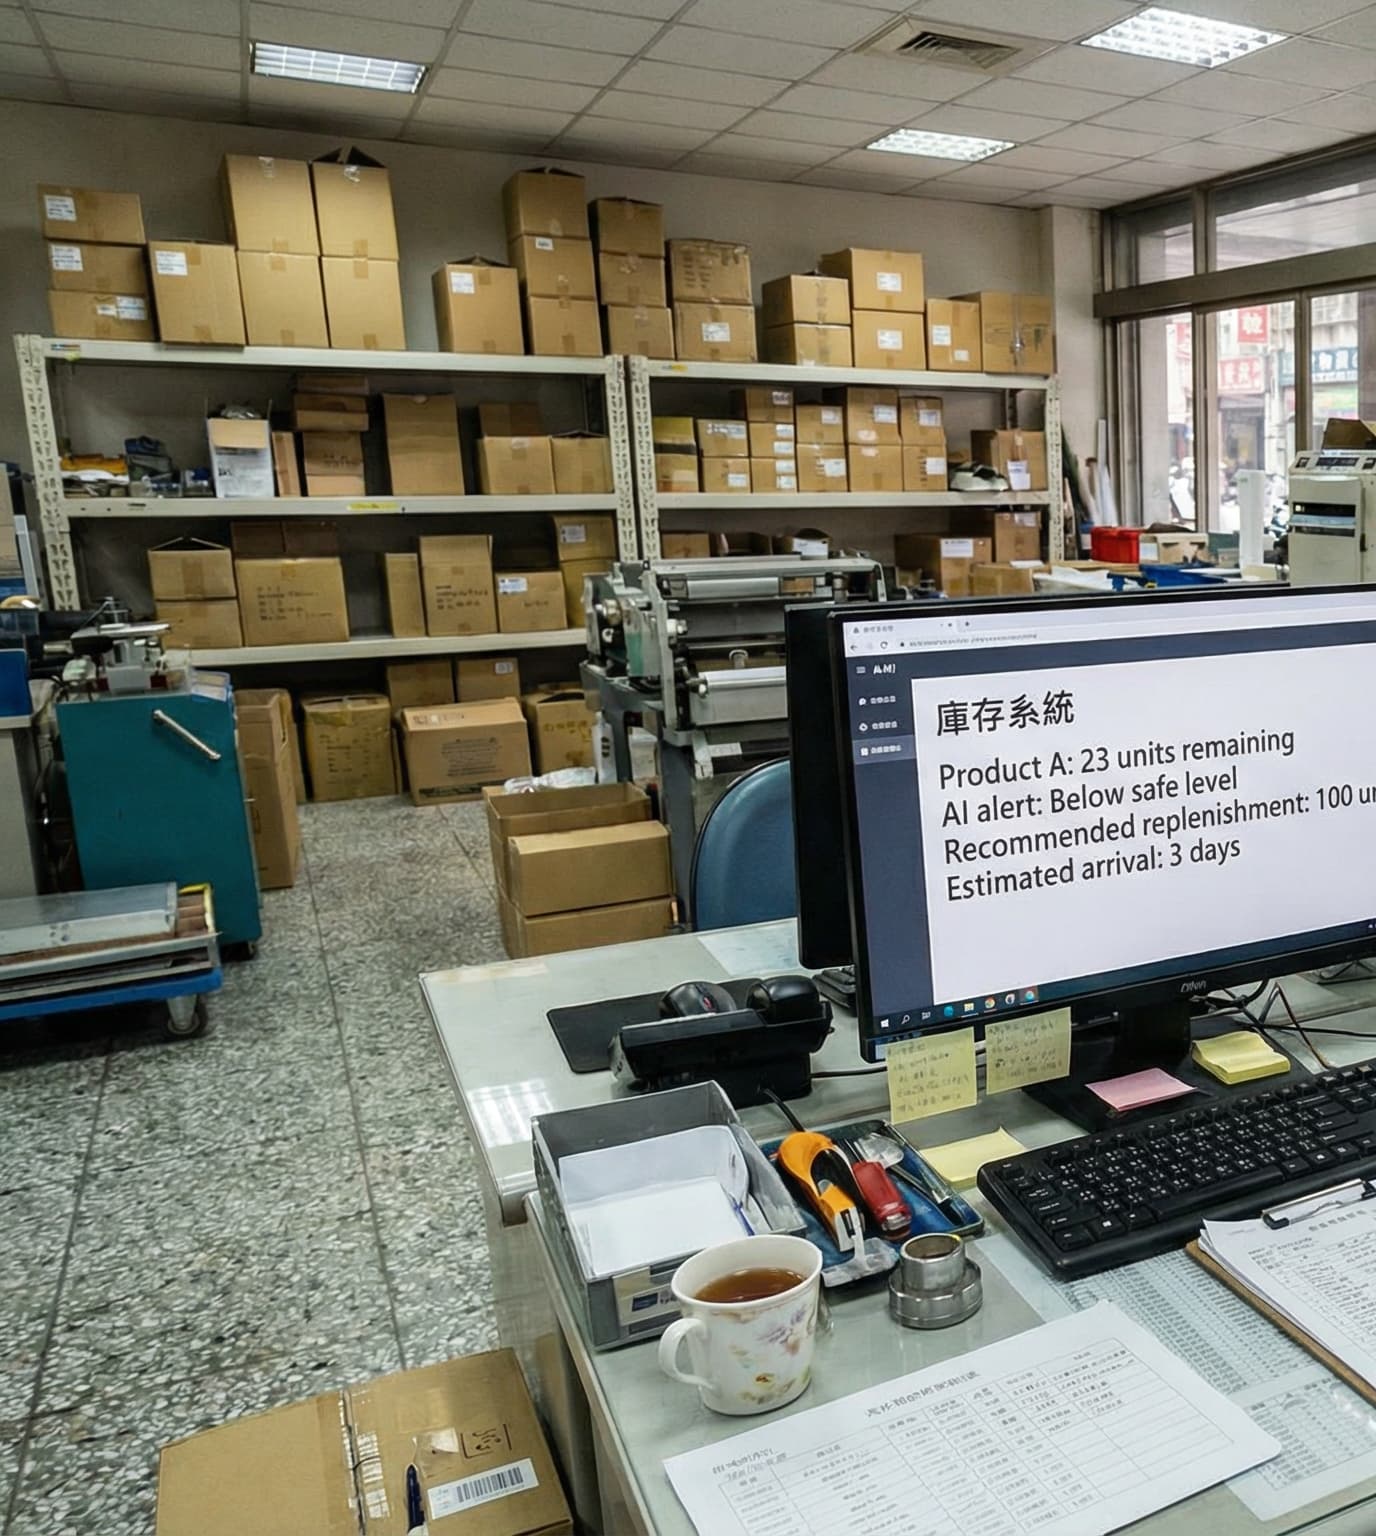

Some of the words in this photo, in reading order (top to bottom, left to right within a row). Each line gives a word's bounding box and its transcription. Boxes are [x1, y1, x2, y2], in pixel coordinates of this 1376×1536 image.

[936, 689, 1075, 737] 庫存系統
[939, 756, 1043, 790] Product
[1049, 751, 1074, 777] A:
[1080, 746, 1110, 774] 23
[1117, 740, 1176, 769] units
[1182, 728, 1295, 762] remaining
[942, 799, 969, 828] AI
[977, 794, 1043, 823] alert:
[1050, 783, 1125, 814] Below
[1131, 773, 1179, 803] safe
[1185, 765, 1238, 796] level
[944, 812, 1136, 865] Recommended
[1143, 792, 1310, 840] replenishment:
[1315, 784, 1353, 810] 100
[947, 857, 1074, 902] Estimated
[1081, 845, 1163, 881] arrival:
[1170, 842, 1183, 867] 3
[1190, 837, 1241, 866] days
